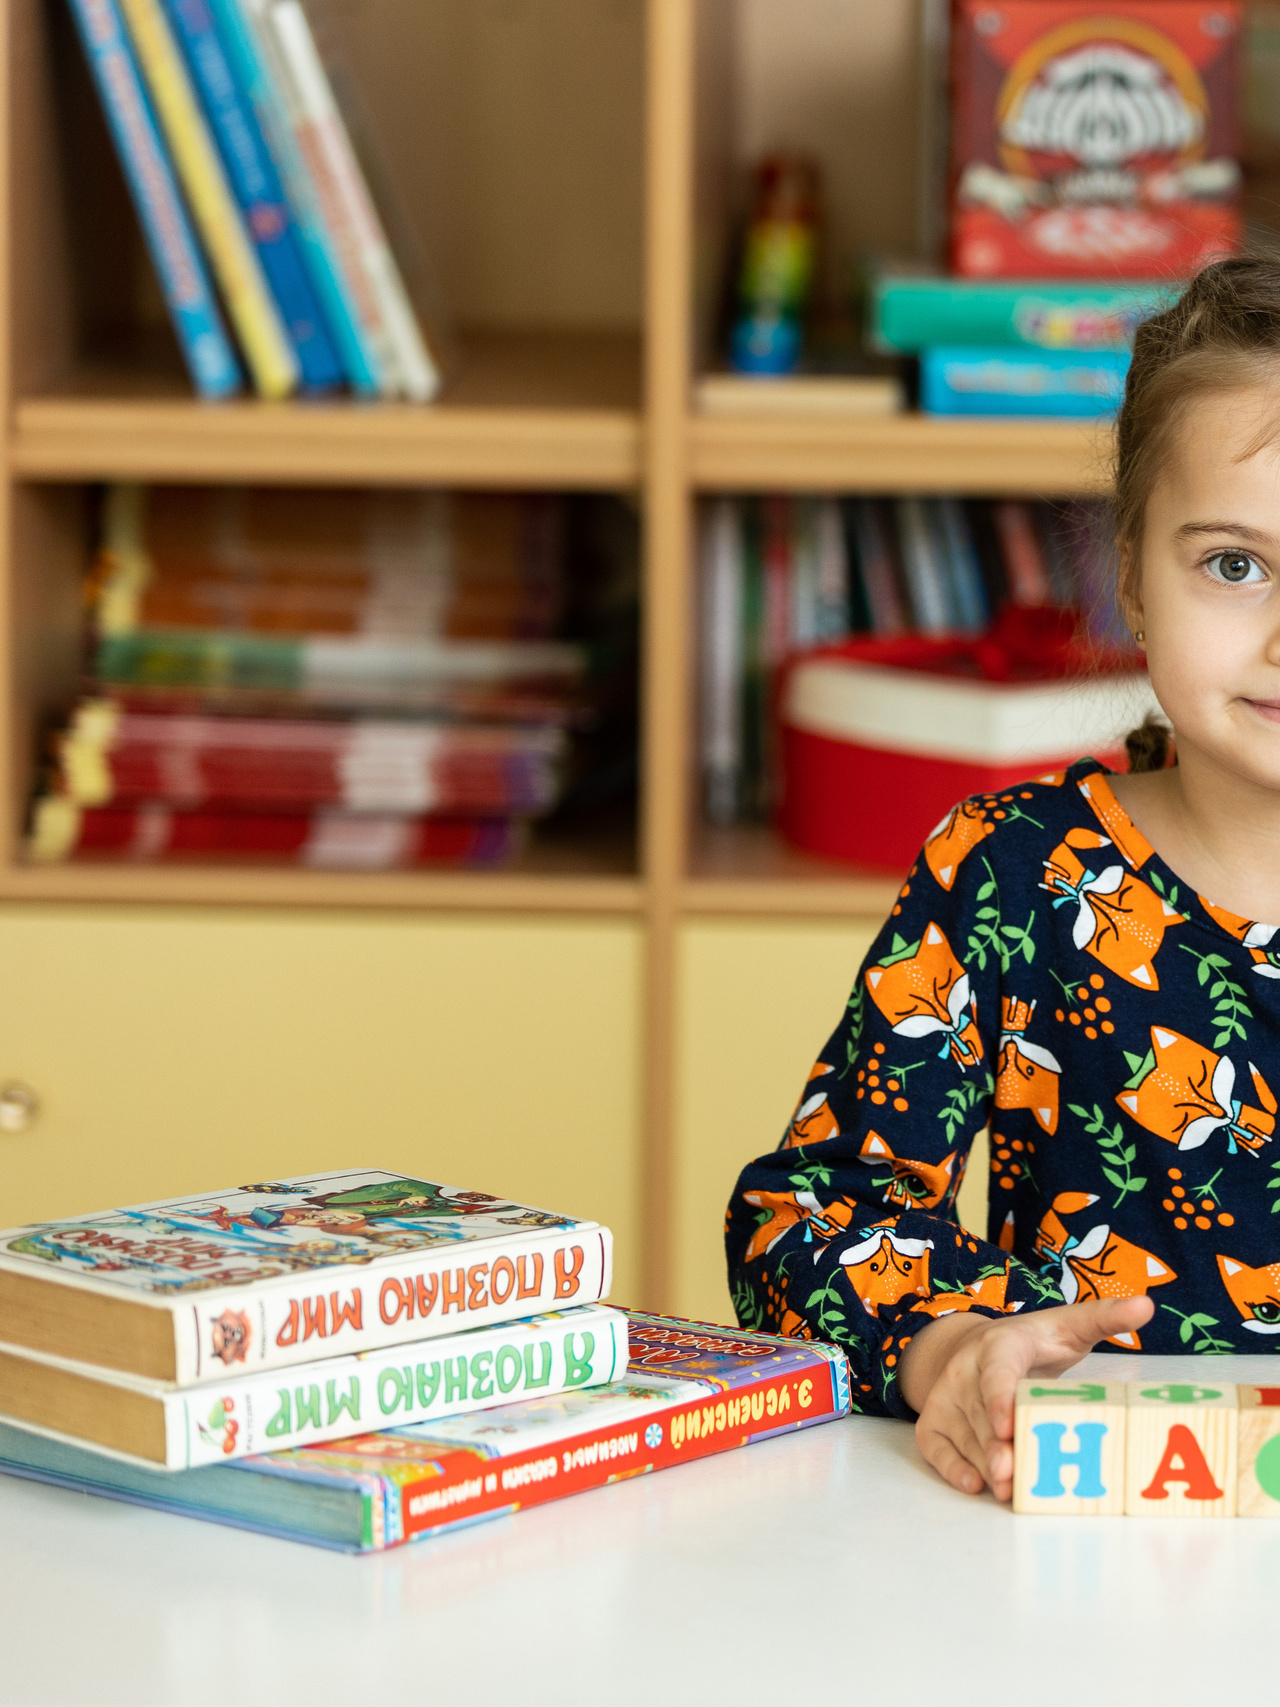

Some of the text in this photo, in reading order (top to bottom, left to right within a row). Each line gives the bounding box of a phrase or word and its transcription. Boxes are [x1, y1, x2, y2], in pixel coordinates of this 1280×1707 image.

[379, 1252, 544, 1327] ПОЗНАЮ
[554, 1246, 585, 1300] Я
[275, 1287, 363, 1348] МИР
[378, 1341, 552, 1416] ПОЗНАЮ
[562, 1331, 595, 1389] Я
[265, 1376, 361, 1439] МИР
[669, 1378, 814, 1450] Э. УСПЕНСКИЙ
[1140, 1384, 1223, 1404] Ф
[502, 1456, 558, 1491] СКАЗКИ
[563, 1432, 639, 1474] ЛЮБИМЫЕ
